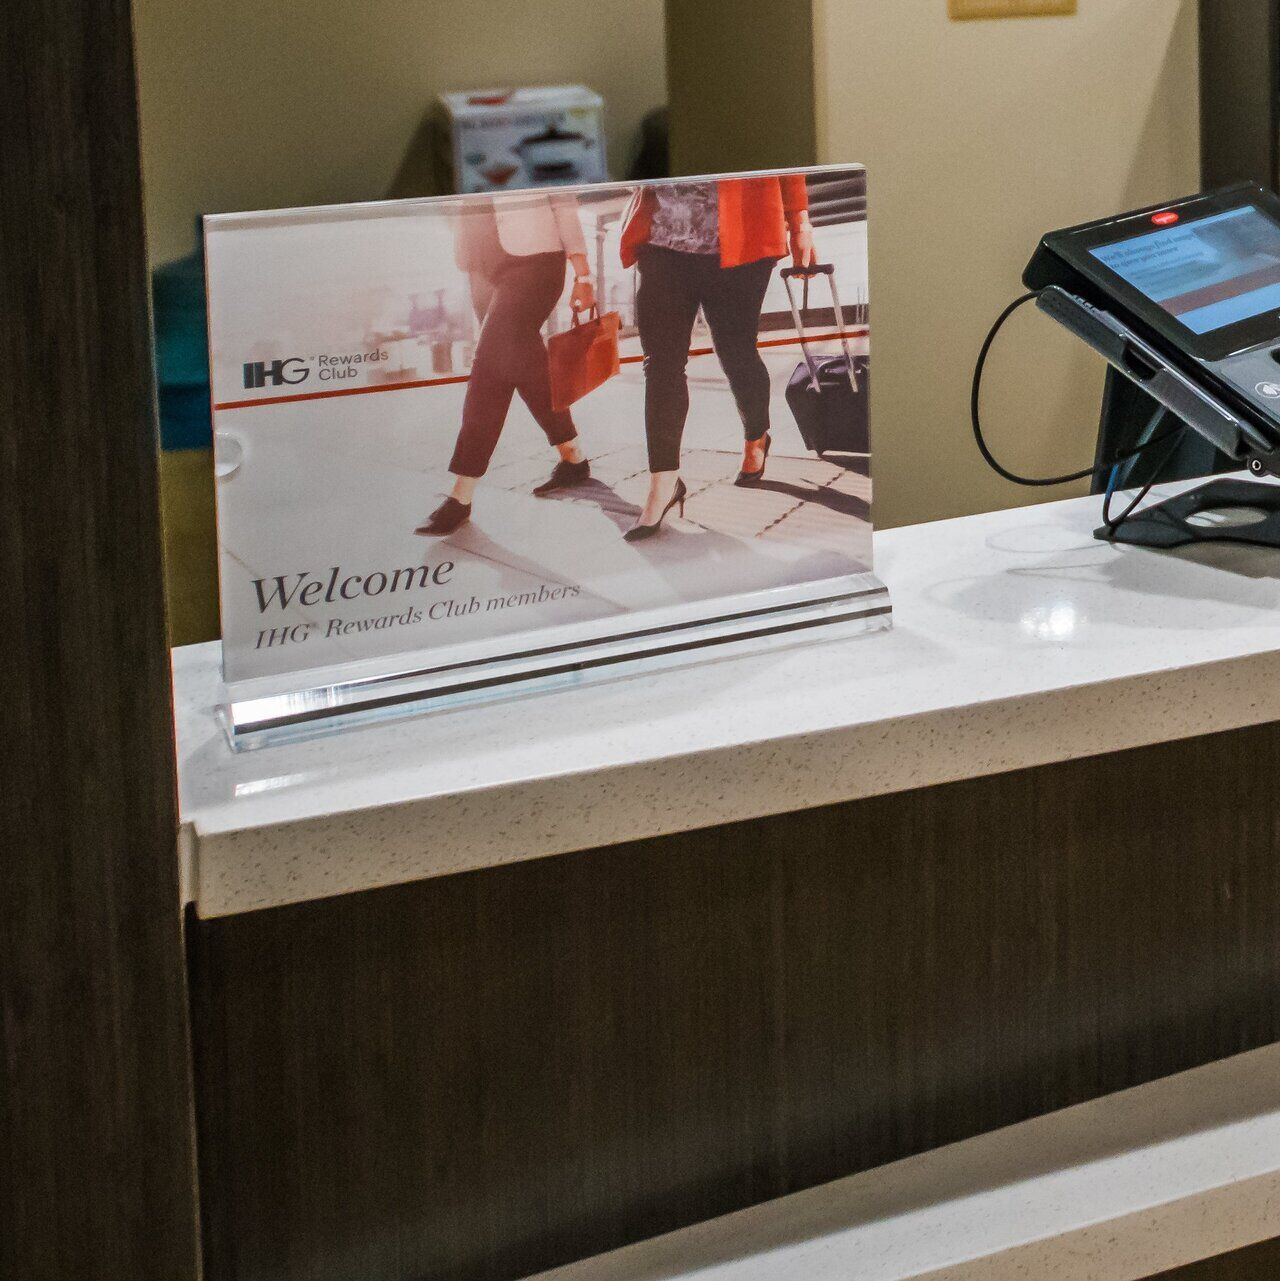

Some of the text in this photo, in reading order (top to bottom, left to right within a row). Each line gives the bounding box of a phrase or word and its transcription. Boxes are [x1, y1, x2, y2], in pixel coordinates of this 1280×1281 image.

[318, 348, 389, 367] Rewards
[319, 366, 358, 381] Club
[251, 561, 456, 614] Welcome
[324, 606, 424, 639] Rewards
[429, 596, 480, 623] Club
[486, 585, 583, 613] members
